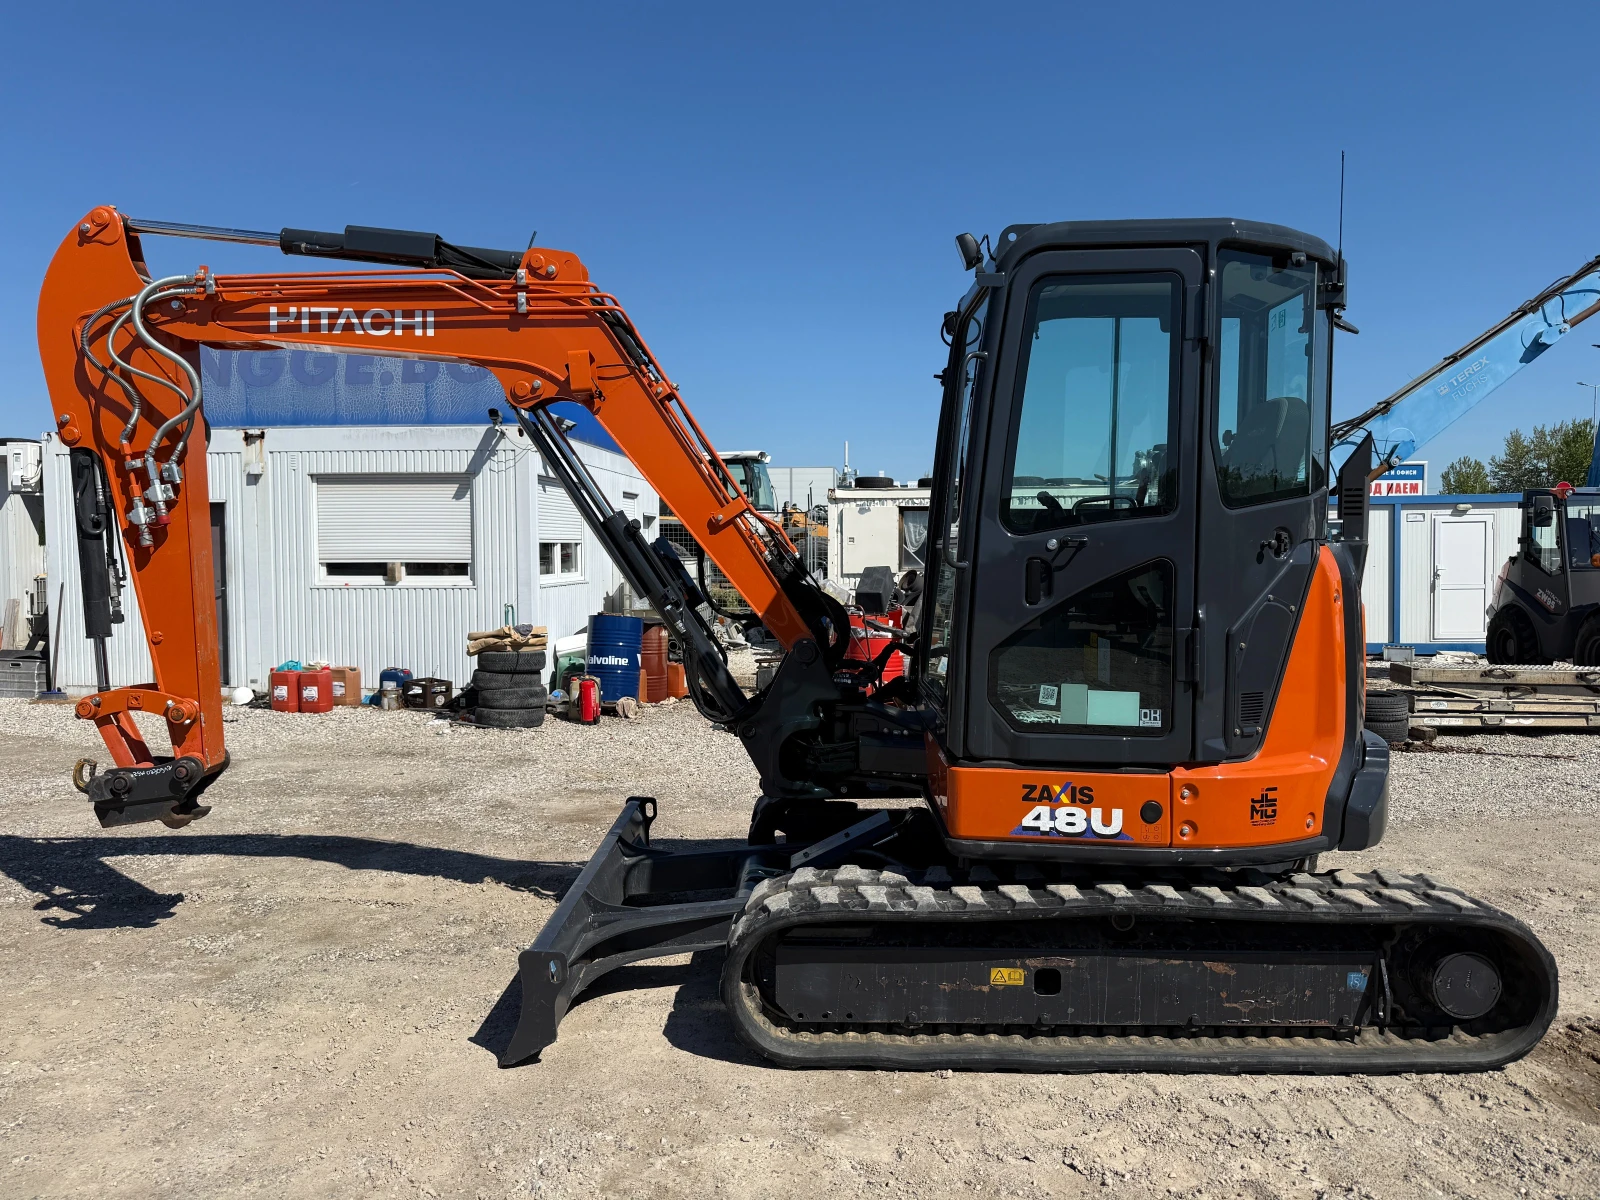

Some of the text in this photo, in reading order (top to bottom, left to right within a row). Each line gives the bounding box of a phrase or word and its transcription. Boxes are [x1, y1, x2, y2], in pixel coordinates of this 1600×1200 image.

[269, 306, 435, 337] HITACHI
[1449, 356, 1489, 386] TEREX
[1452, 373, 1488, 401] FUCHS
[1536, 588, 1556, 609] ZW95
[587, 654, 629, 666] alvoline
[1021, 781, 1095, 805] ZAXIS
[1021, 805, 1123, 839] 48U
